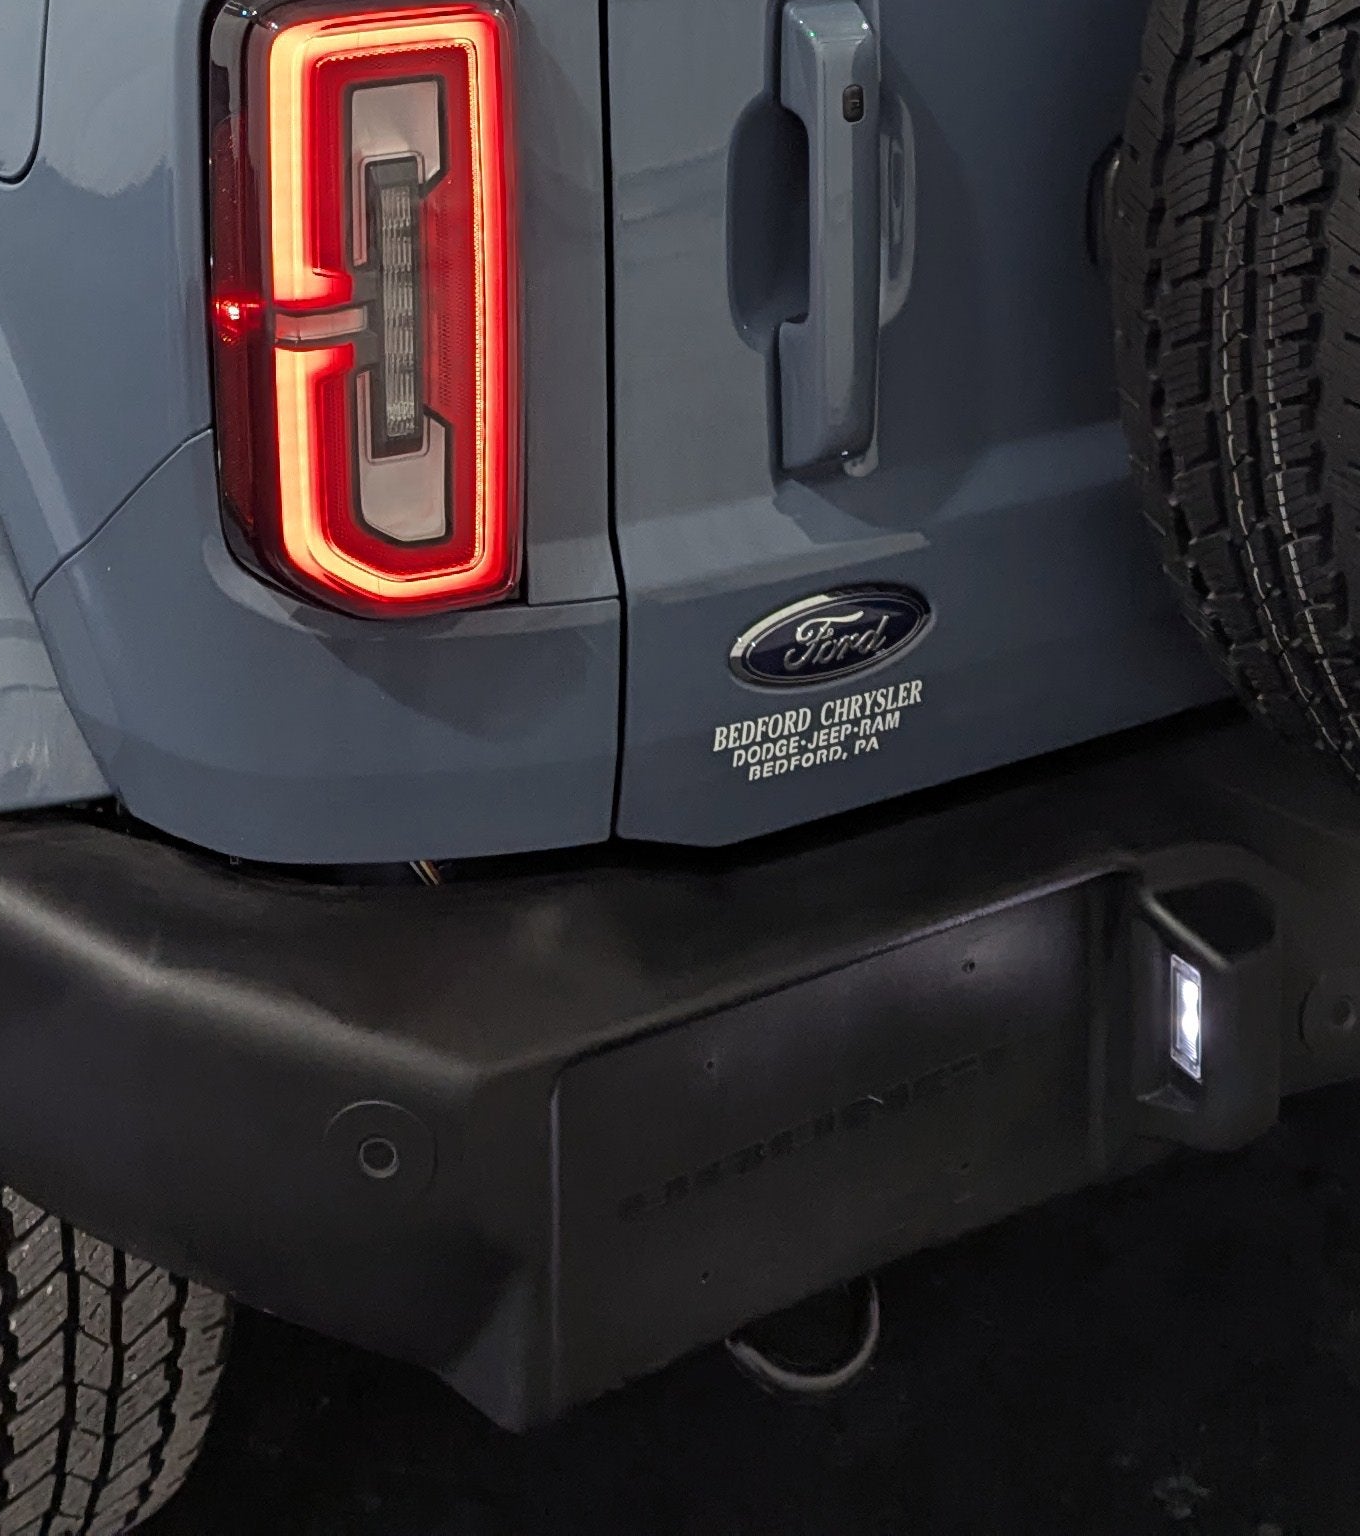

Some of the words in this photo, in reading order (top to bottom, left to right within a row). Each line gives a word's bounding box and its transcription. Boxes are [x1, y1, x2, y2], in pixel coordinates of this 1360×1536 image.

[783, 610, 890, 671] Ford
[713, 707, 812, 752] BEDFORD
[820, 680, 923, 726] CHRYSLER
[854, 736, 880, 758] PA
